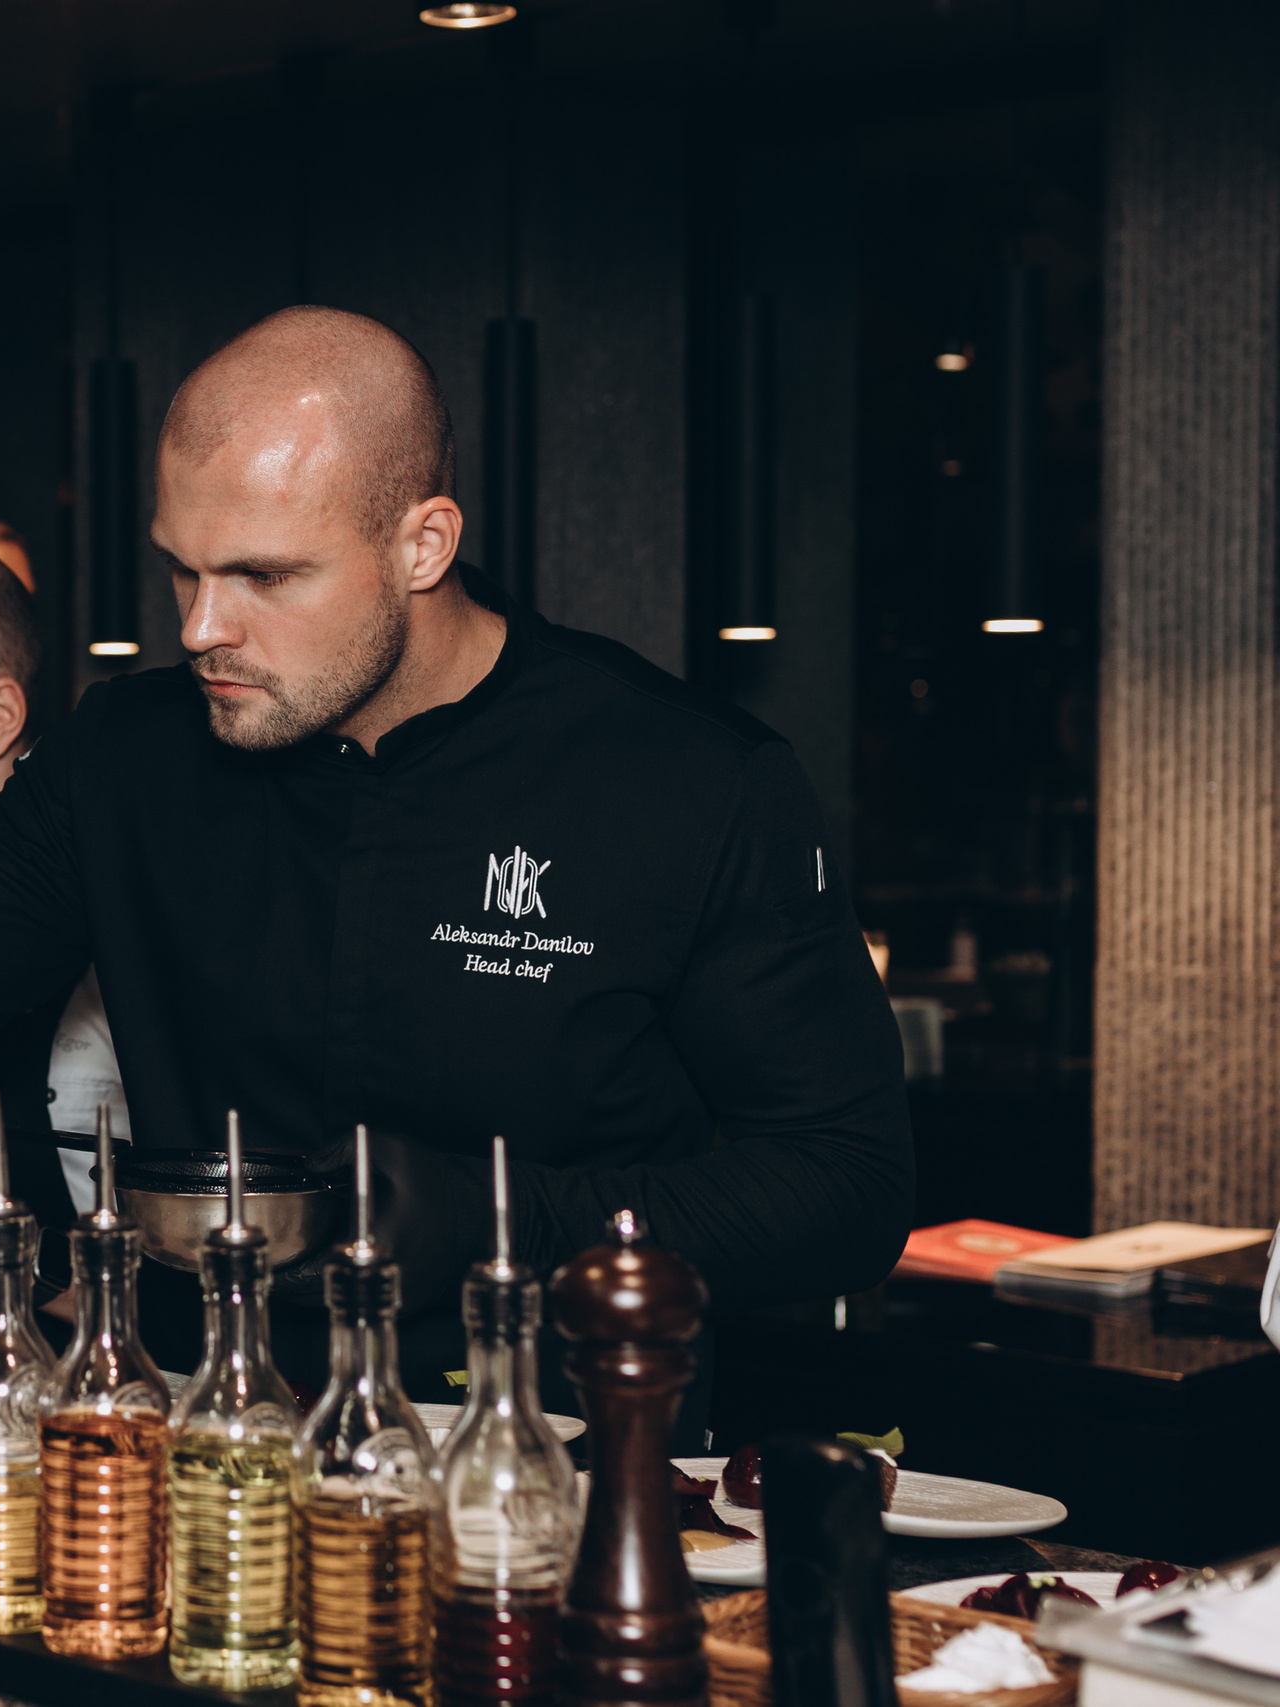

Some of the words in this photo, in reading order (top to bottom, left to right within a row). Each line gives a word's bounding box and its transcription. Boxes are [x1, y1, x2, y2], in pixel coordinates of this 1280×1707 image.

[430, 923, 521, 949] Aleksandr
[521, 931, 595, 956] Danilov
[463, 953, 511, 976] Head
[515, 960, 554, 984] chef
